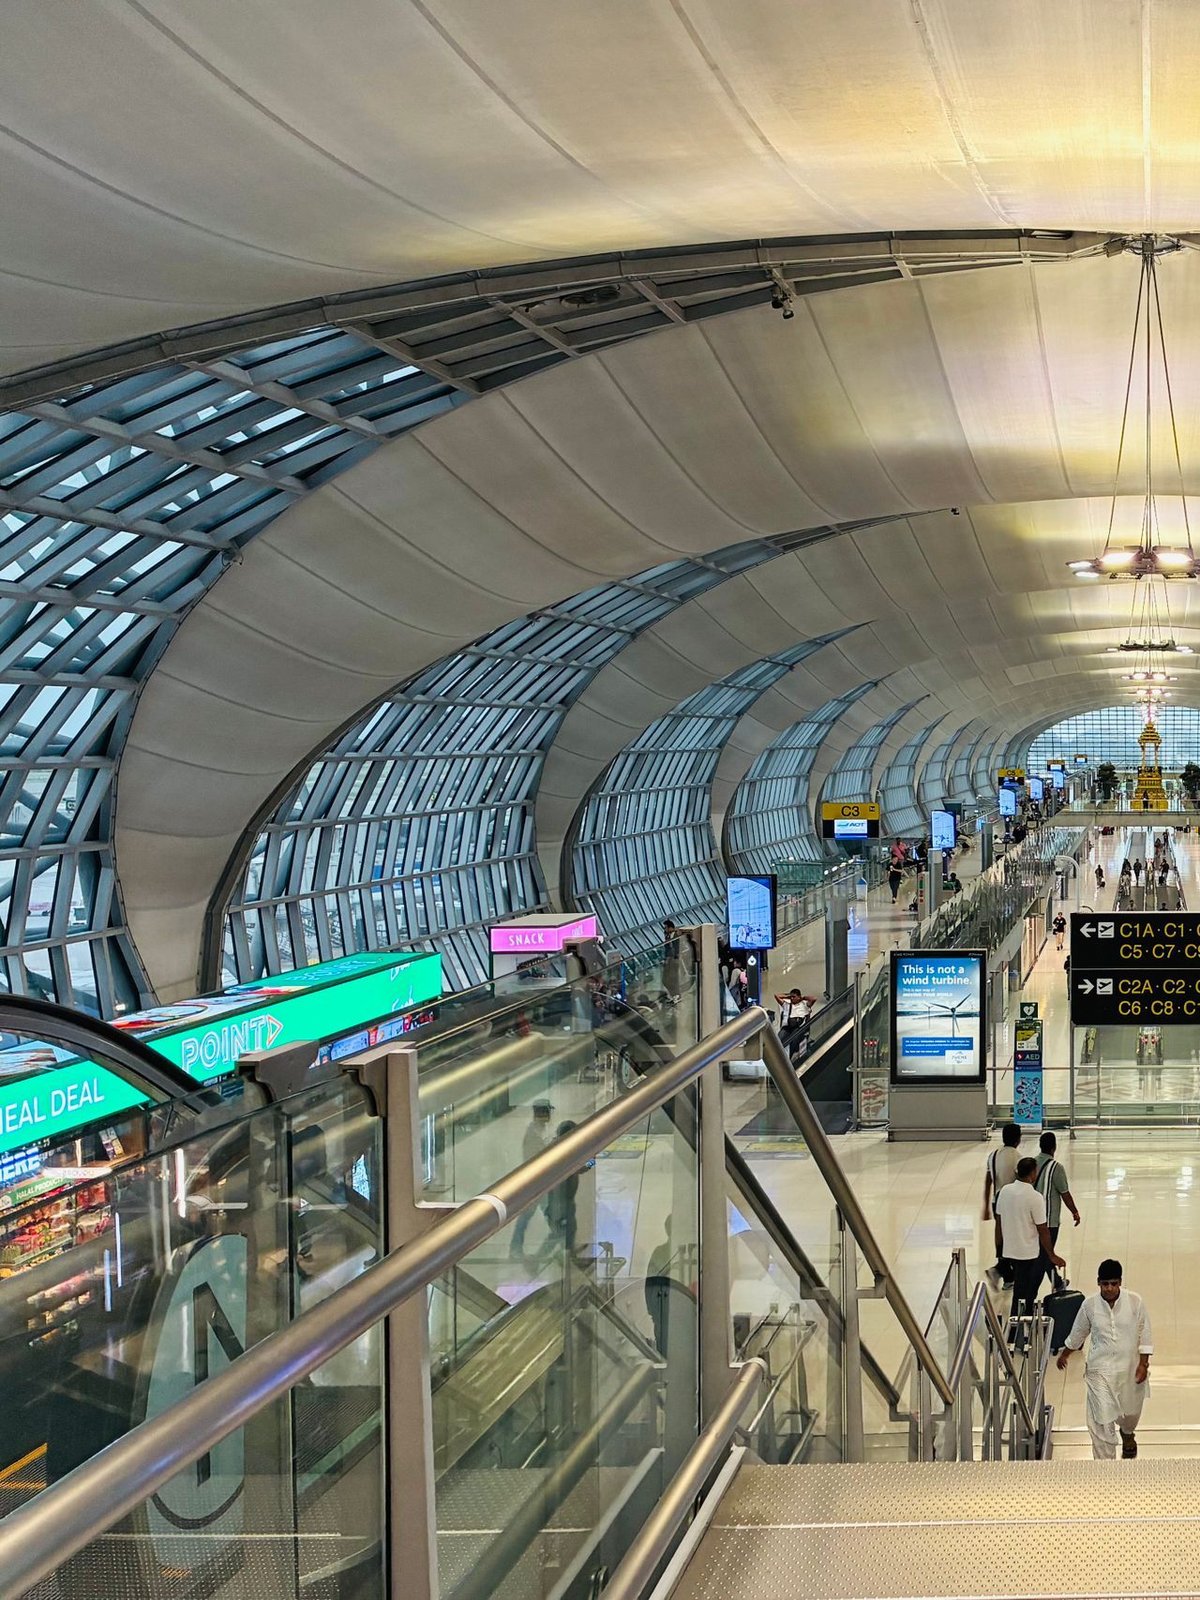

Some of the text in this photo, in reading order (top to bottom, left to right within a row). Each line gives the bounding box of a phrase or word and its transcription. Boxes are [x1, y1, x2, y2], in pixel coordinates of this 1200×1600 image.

[841, 805, 860, 817] C3
[1119, 923, 1154, 938] C1A
[1164, 923, 1184, 938] C1
[509, 933, 544, 946] SNACK
[1119, 944, 1142, 958] C5
[1152, 944, 1175, 958] C7
[902, 965, 924, 974] This
[927, 965, 934, 974] is
[938, 966, 955, 974] not
[902, 976, 972, 985] wind turbine.
[1118, 980, 1153, 994] C2A
[1162, 980, 1185, 994] C2
[1118, 1001, 1141, 1015] C6
[1151, 1001, 1174, 1015] C8
[182, 1014, 267, 1073] POINT
[0, 1078, 105, 1134] EAL DEAL
